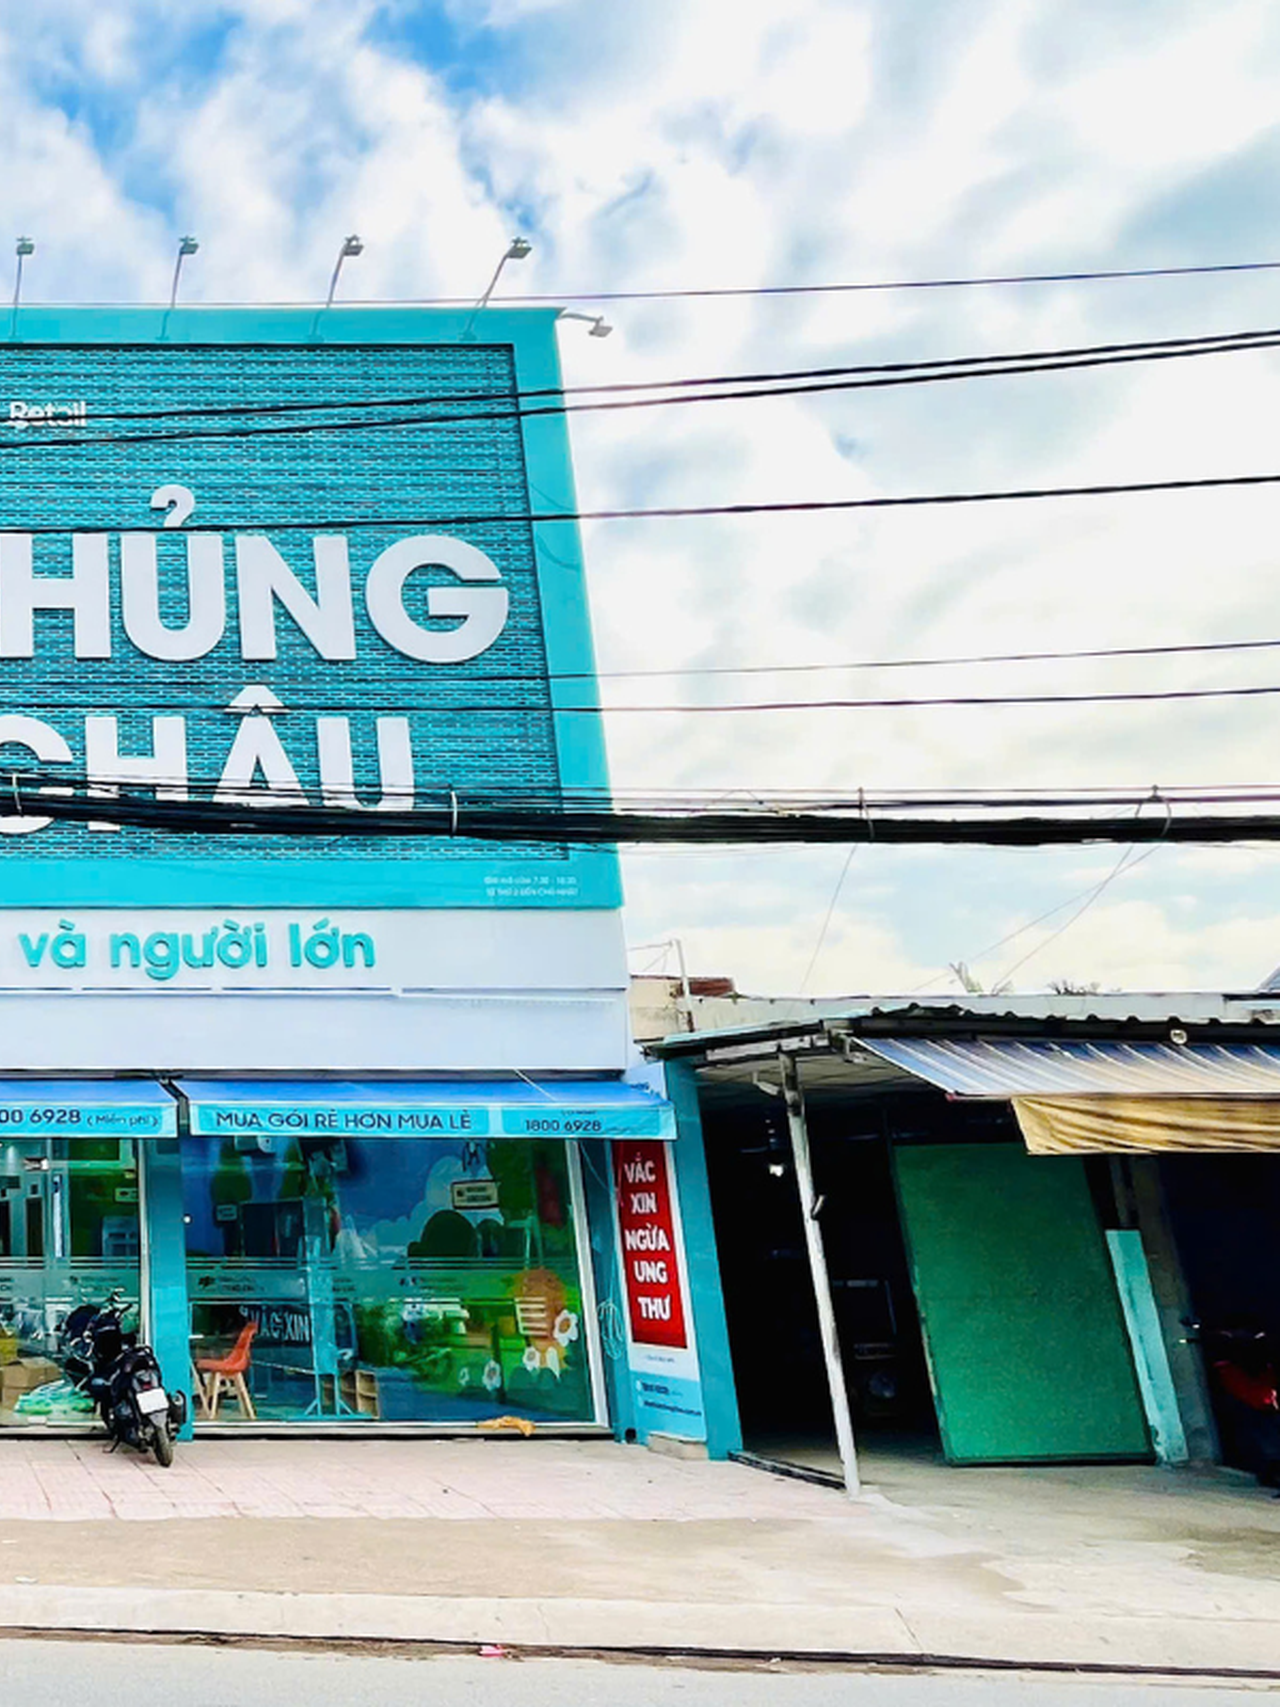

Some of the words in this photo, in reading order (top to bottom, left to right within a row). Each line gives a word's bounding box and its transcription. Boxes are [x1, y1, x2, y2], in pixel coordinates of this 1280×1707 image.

[9, 401, 88, 428] Retail
[18, 918, 86, 968] và
[108, 917, 268, 981] người
[288, 917, 376, 968] lớn
[28, 1107, 83, 1124] 6928
[215, 1112, 263, 1127] MUA
[267, 1108, 309, 1128] GÓI
[314, 1108, 339, 1128] RẺ
[344, 1111, 392, 1129] HƠN
[397, 1113, 444, 1130] MUA
[449, 1109, 472, 1130] LẺ
[524, 1119, 560, 1132] 1800
[563, 1119, 602, 1132] 6928
[630, 1192, 658, 1214] XIN
[624, 1222, 670, 1251] NGỪA
[633, 1260, 669, 1284] UNG
[637, 1294, 671, 1320] THƯ
